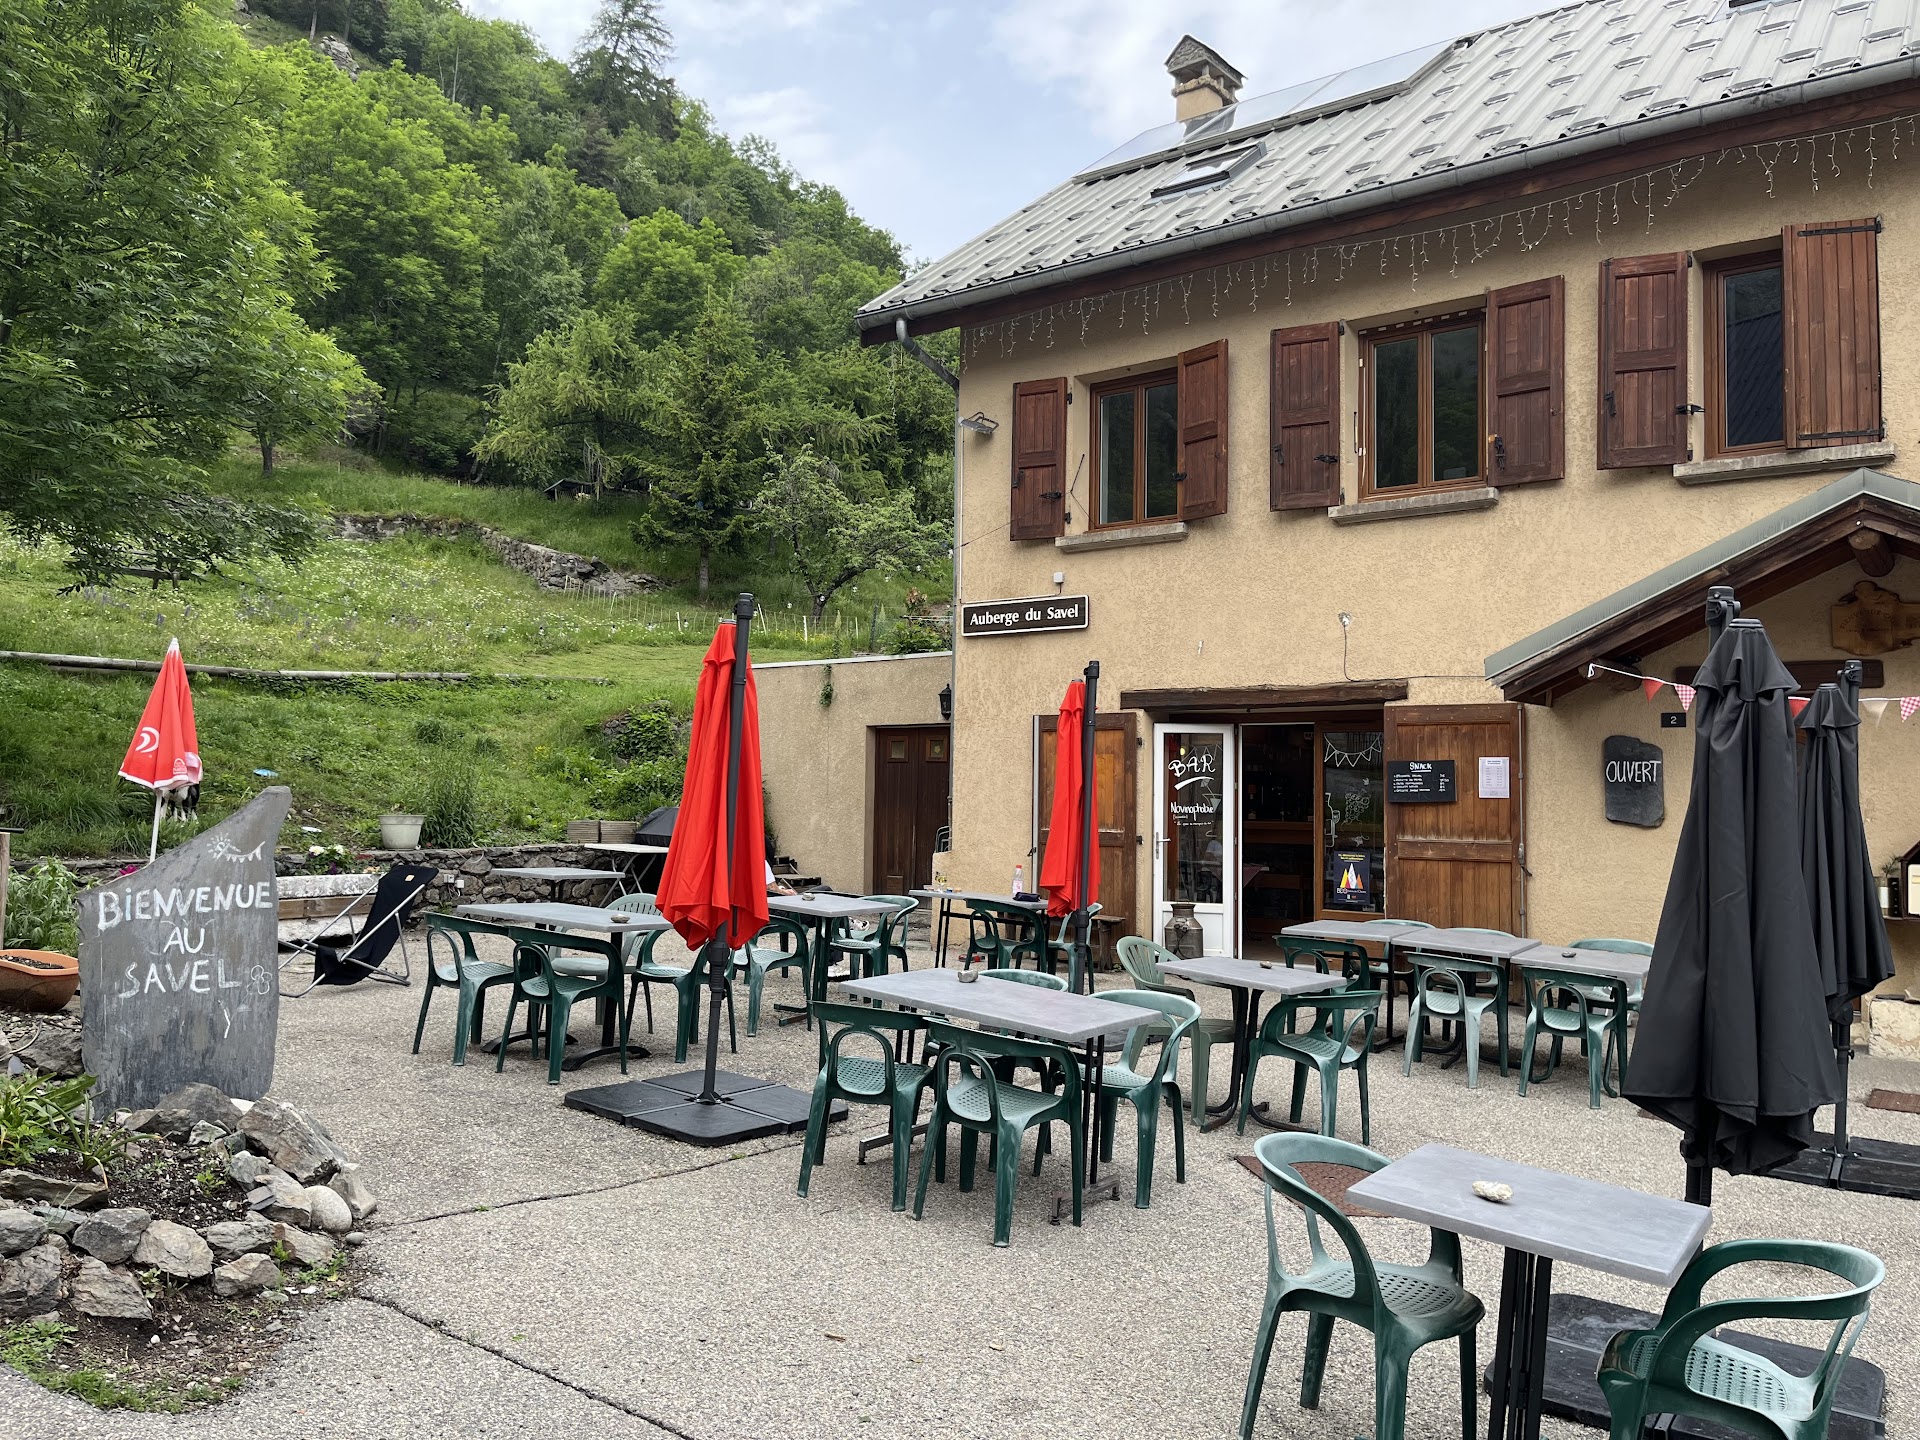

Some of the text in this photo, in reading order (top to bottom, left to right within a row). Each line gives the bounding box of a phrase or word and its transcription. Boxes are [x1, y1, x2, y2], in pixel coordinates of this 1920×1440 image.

[969, 604, 1079, 626] Auberge du Savel
[1670, 716, 1677, 725] 2
[1168, 754, 1216, 777] BAR
[1409, 762, 1433, 771] SNACK
[1605, 760, 1662, 783] OUVERT
[162, 926, 206, 955] AU
[119, 959, 241, 999] SAVEL
